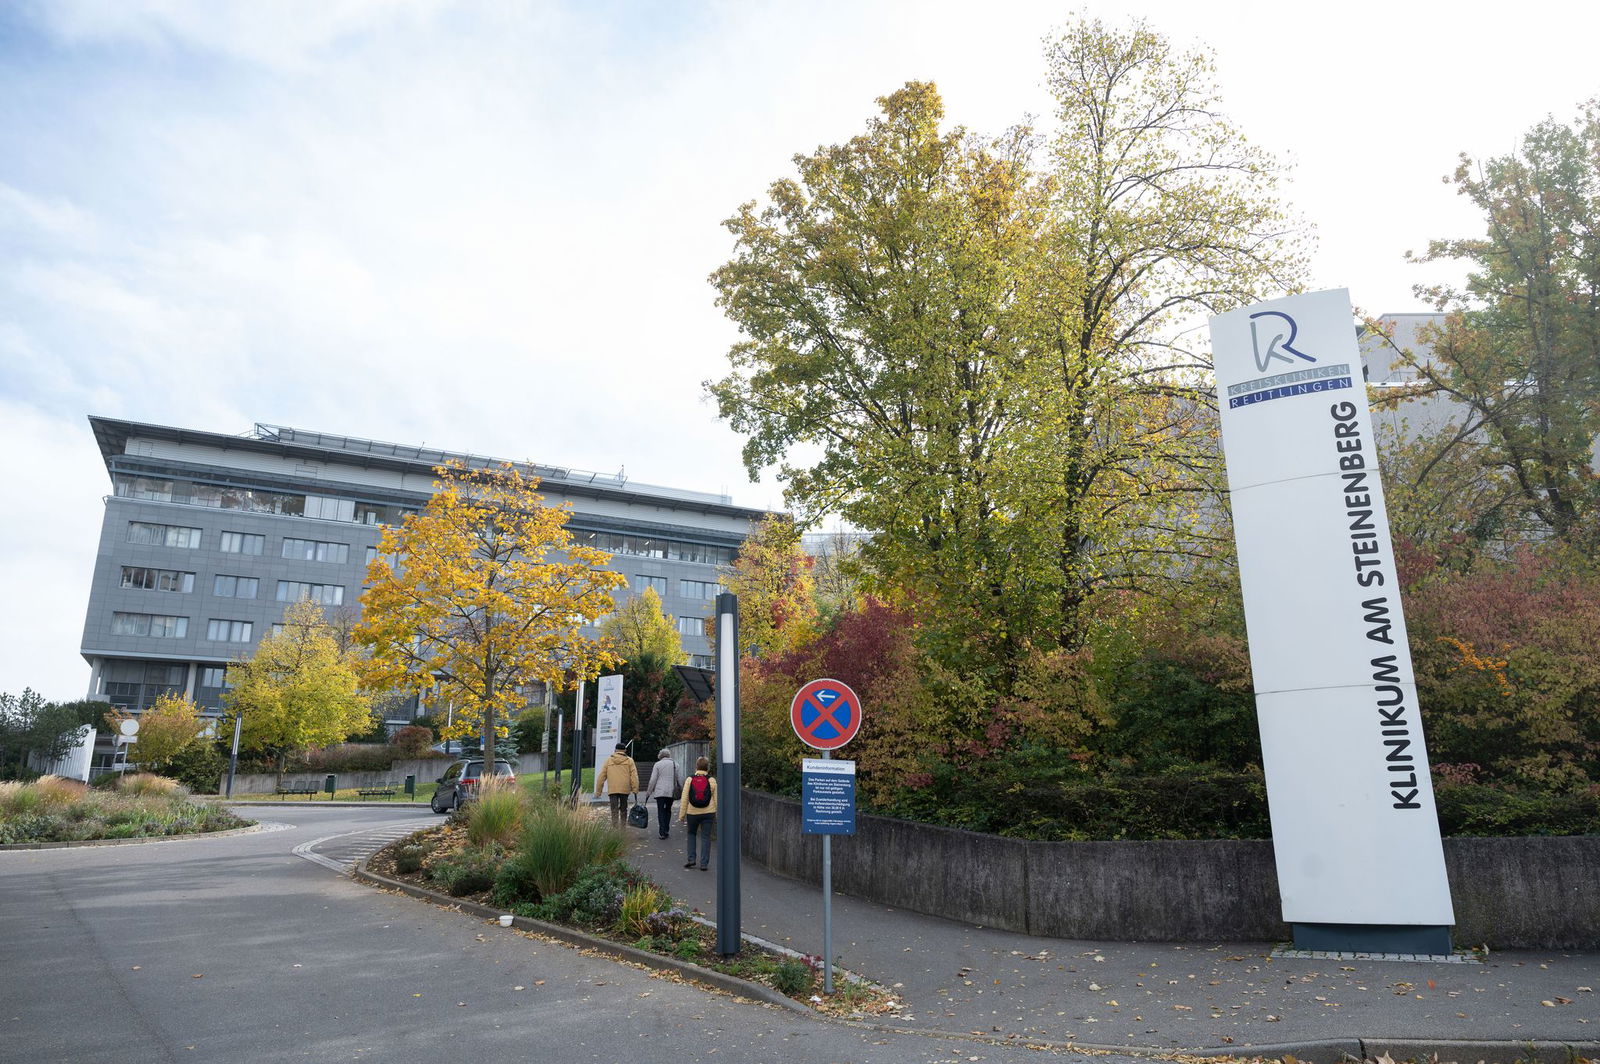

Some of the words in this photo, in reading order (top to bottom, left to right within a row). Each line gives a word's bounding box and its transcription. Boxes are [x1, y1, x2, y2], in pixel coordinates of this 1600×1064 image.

[1230, 365, 1348, 395] KREISKLINIKEN
[1231, 378, 1349, 408] REUTLINGEN
[1330, 401, 1384, 587] STEINENBERG
[1361, 597, 1394, 645] AM
[1370, 655, 1421, 809] KLINIKUM
